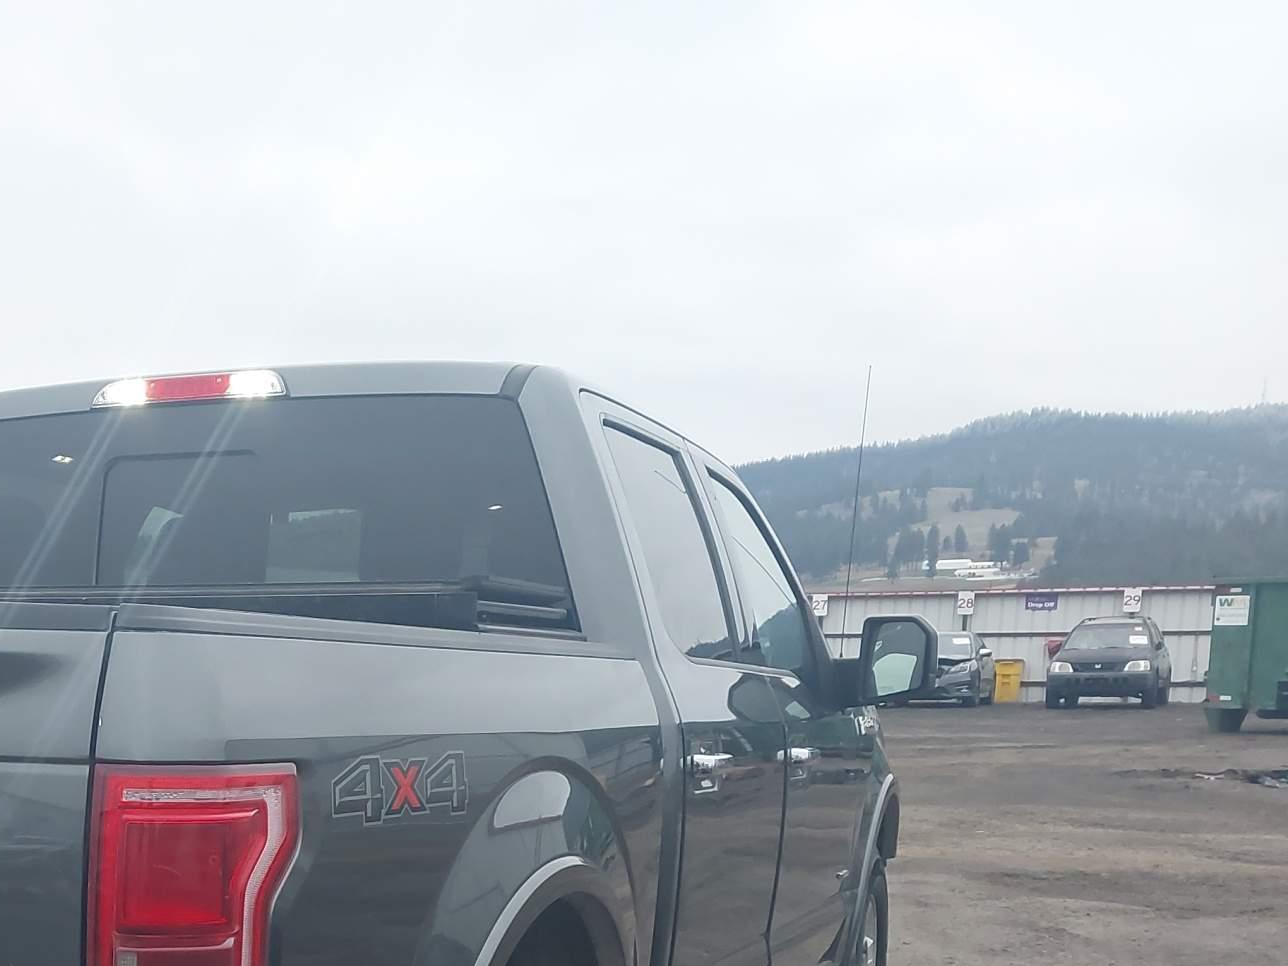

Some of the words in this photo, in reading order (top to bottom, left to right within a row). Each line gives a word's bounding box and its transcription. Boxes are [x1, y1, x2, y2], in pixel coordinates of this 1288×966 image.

[813, 600, 826, 610] 27
[958, 598, 973, 608] 28
[1124, 595, 1141, 605] 29
